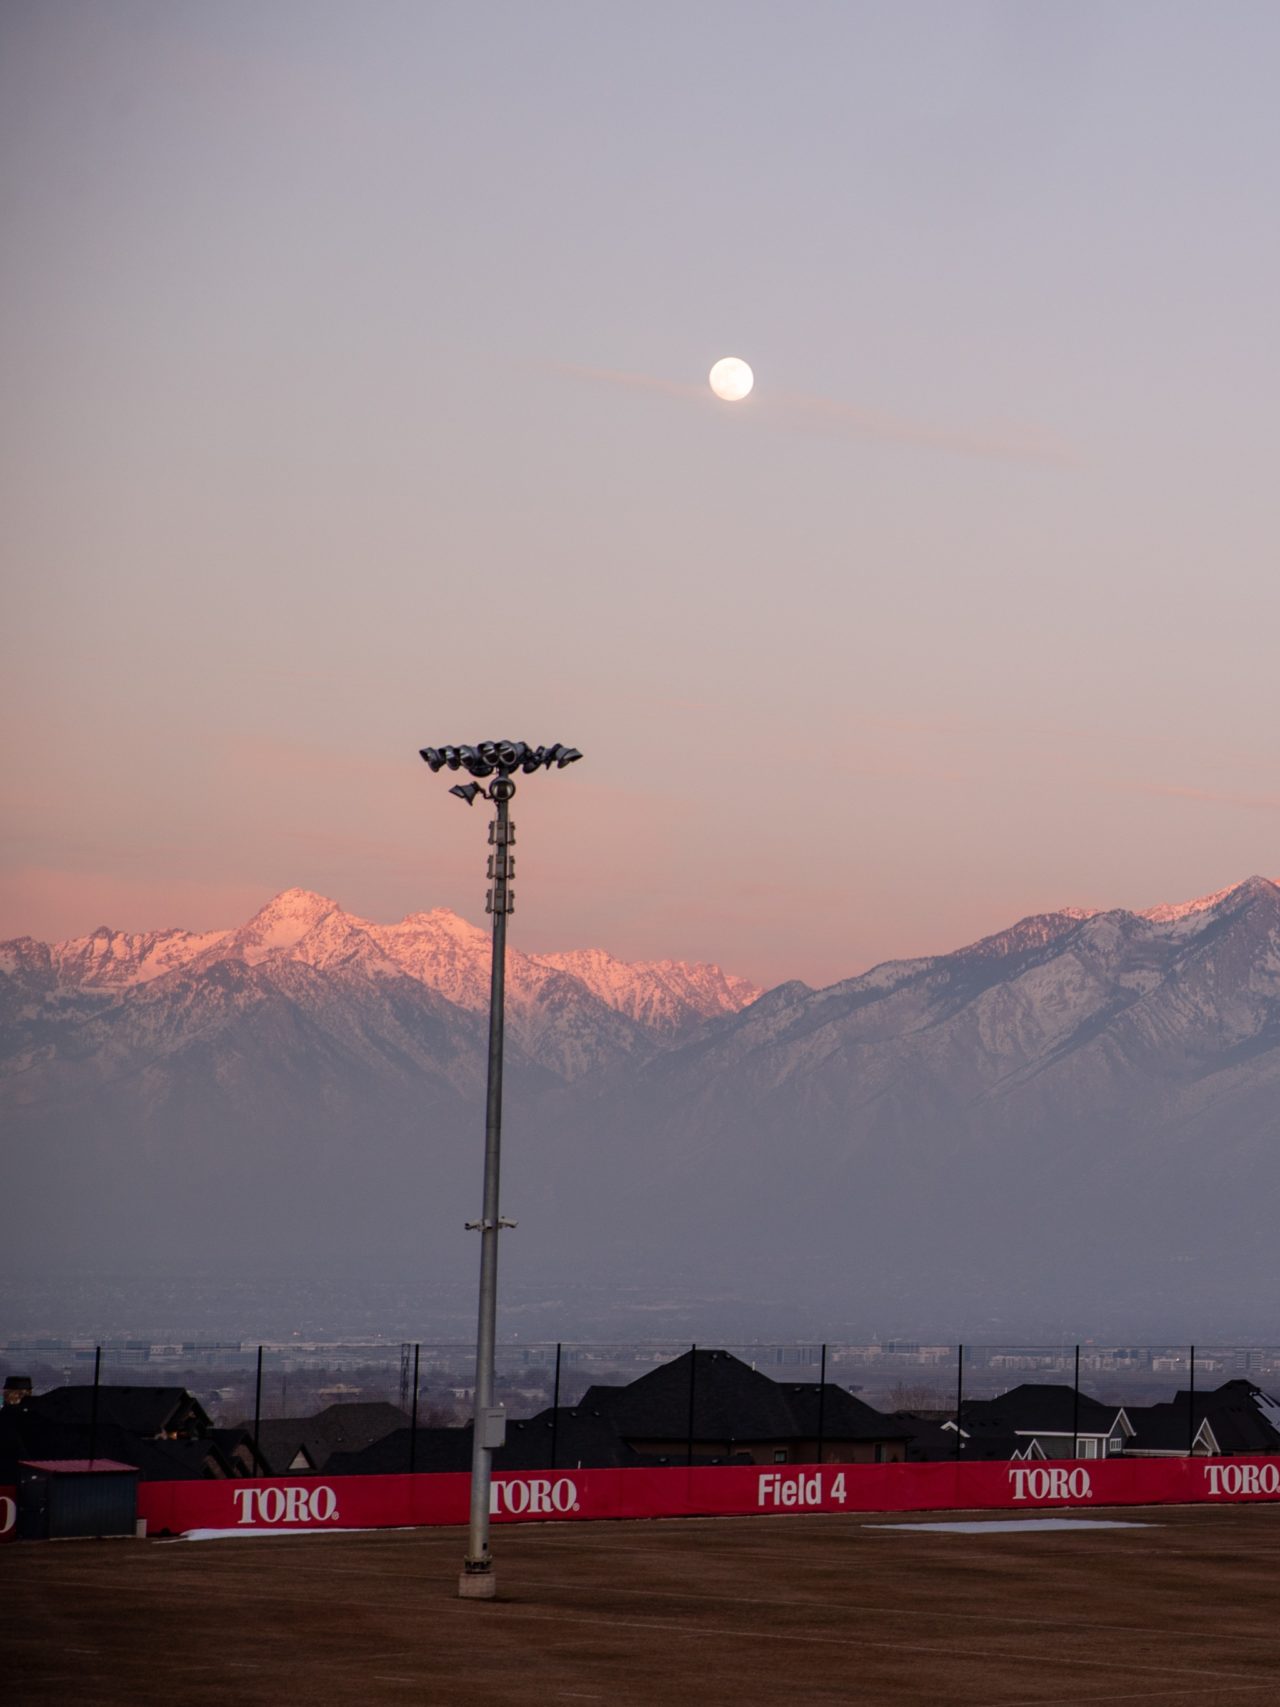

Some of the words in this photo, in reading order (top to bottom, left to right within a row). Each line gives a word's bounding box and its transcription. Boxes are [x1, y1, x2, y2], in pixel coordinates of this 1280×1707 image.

[758, 1472, 822, 1506] Field
[830, 1472, 847, 1504] 4
[1008, 1467, 1092, 1500] TORO
[233, 1486, 339, 1524] TORO
